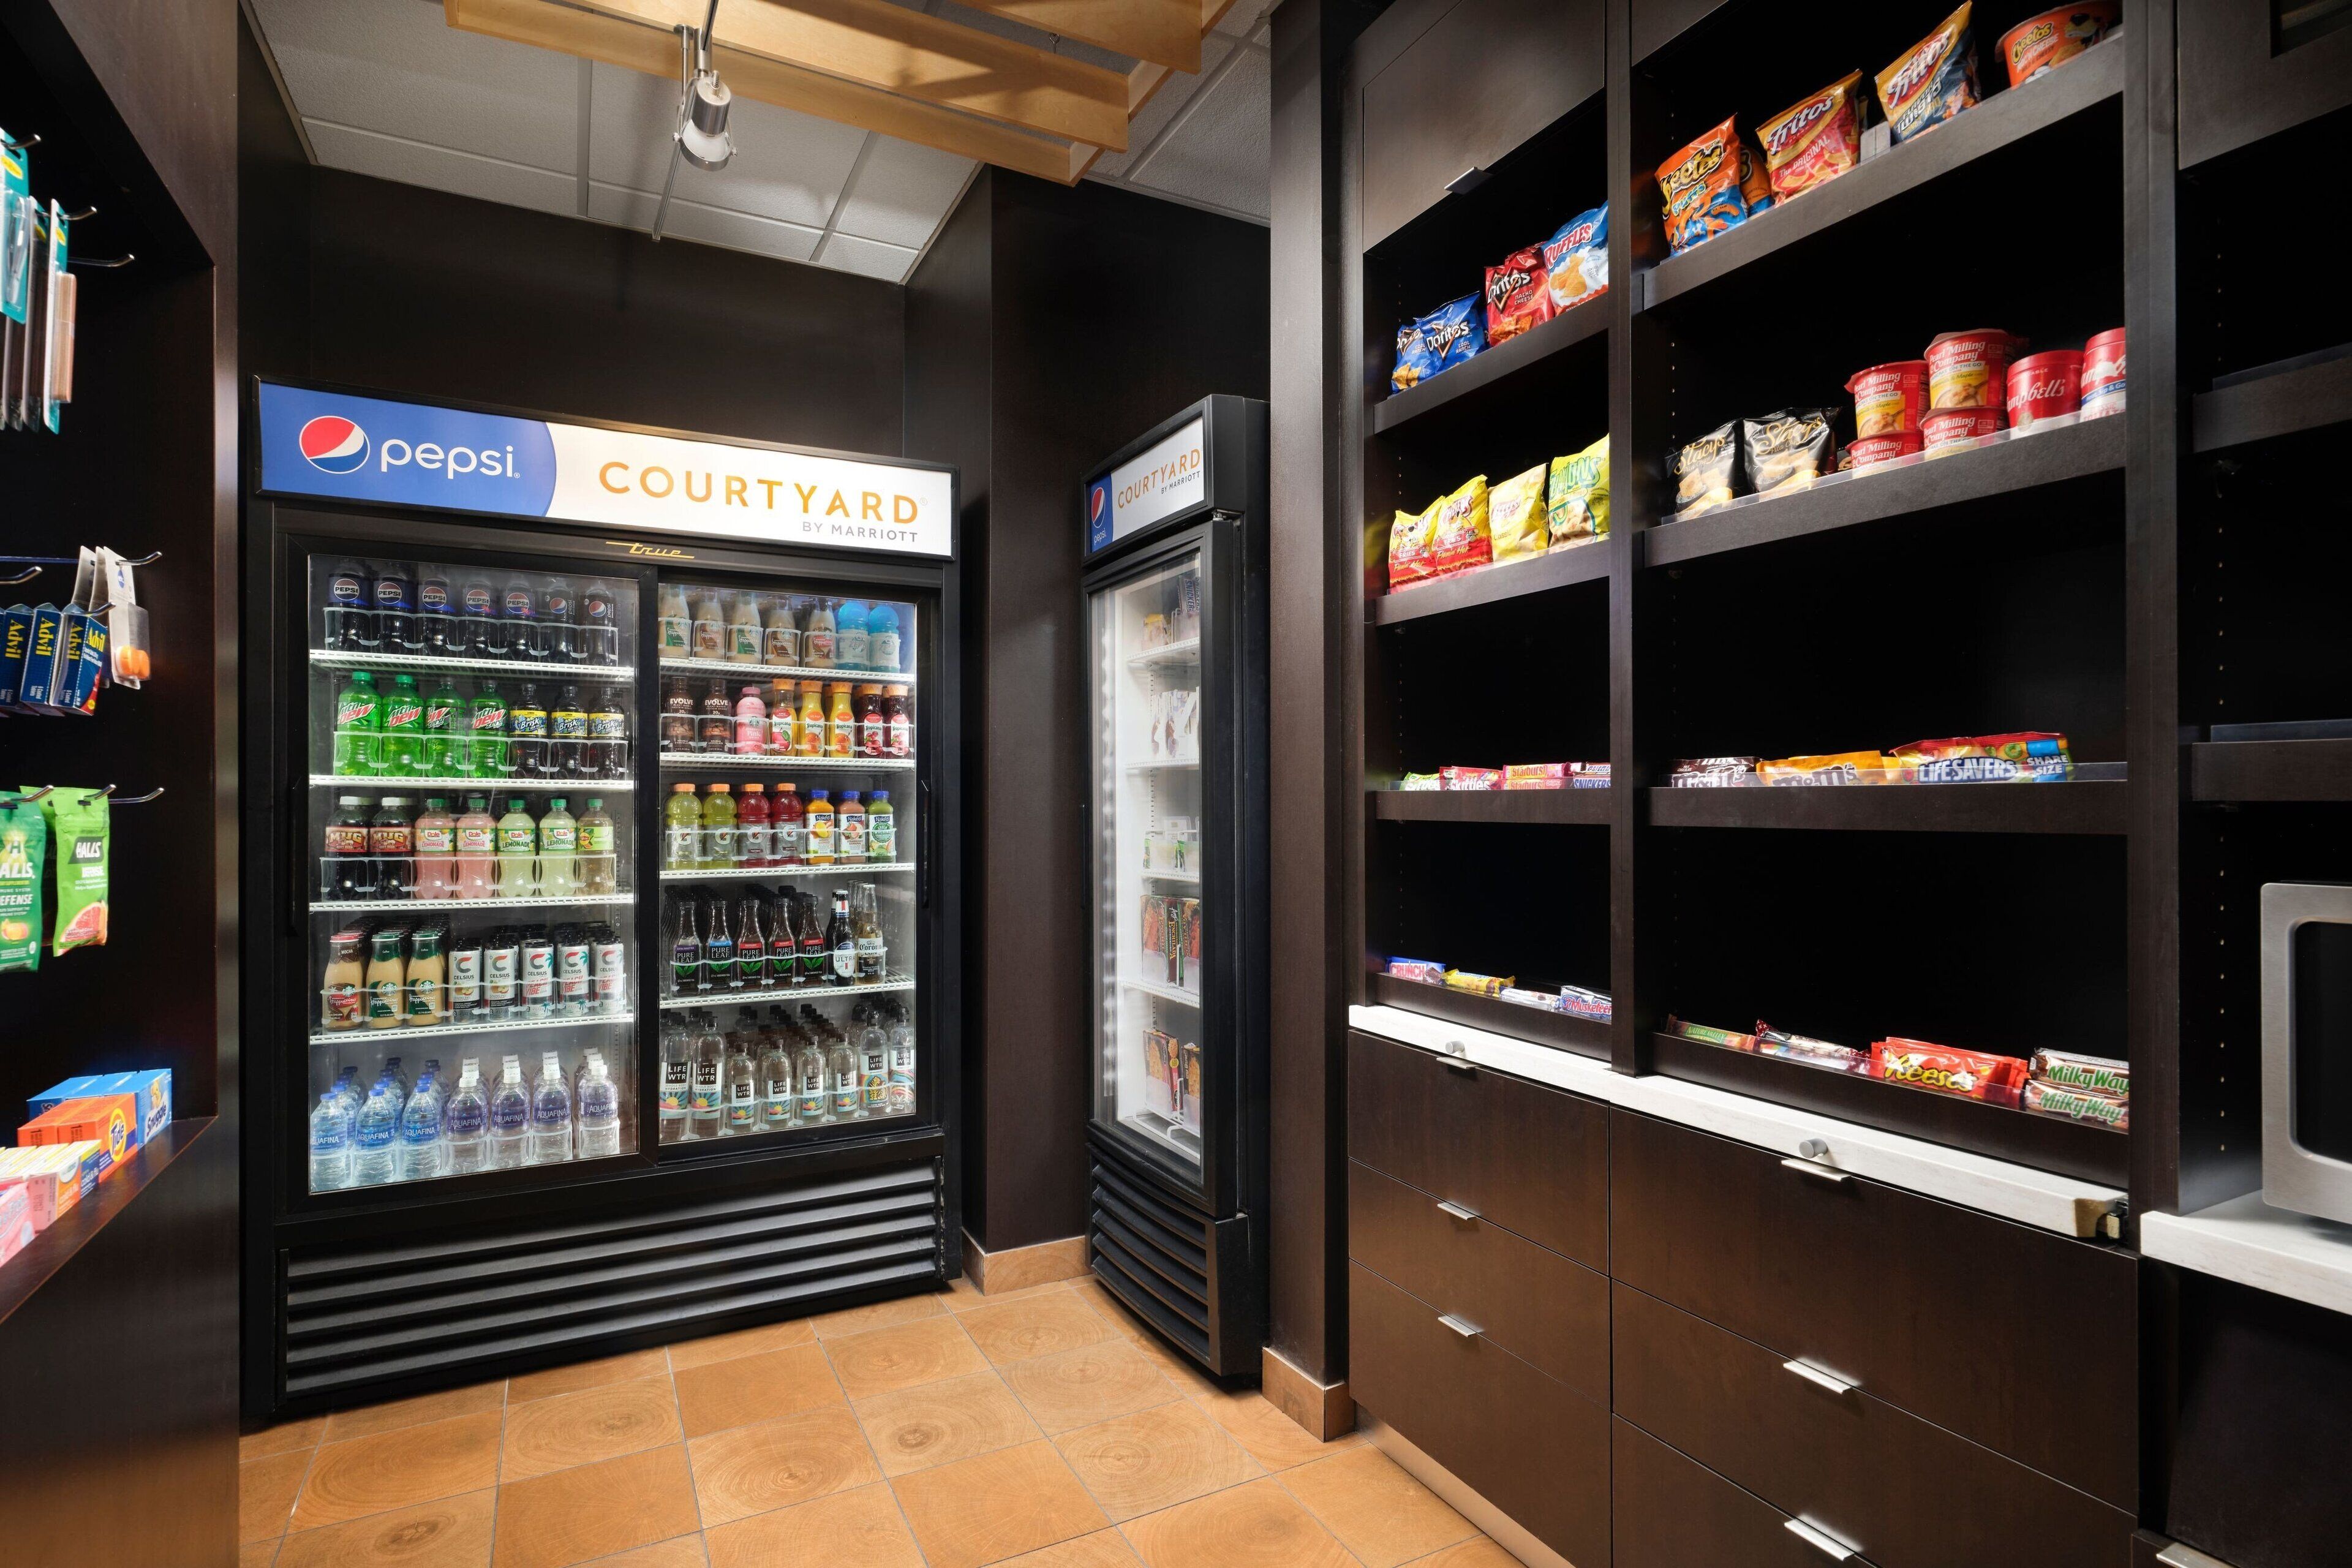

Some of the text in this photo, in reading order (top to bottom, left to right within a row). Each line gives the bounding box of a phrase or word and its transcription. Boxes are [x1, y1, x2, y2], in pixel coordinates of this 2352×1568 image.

[2011, 23, 2053, 64] Cheetos
[1767, 96, 1834, 156] Fritos
[1793, 135, 1830, 169] ORIGINAL
[1544, 223, 1593, 269] RUFFLES
[1487, 271, 1531, 304] Doritos
[1515, 290, 1533, 300] NACHO
[1514, 295, 1534, 305] CHEESE
[1427, 321, 1469, 352] Doritos
[1947, 341, 1986, 355] Milling
[1934, 352, 1979, 370] Company
[1868, 372, 1901, 385] Milling
[1858, 383, 1895, 400] Company
[1939, 417, 1976, 429] Milling
[1755, 417, 1822, 455] Stacy's
[1927, 426, 1968, 445] Company
[1673, 434, 1725, 476] Stacy's
[1868, 440, 1902, 454] Milling
[381, 439, 514, 479] pepsi
[1855, 450, 1896, 467] Company
[1118, 448, 1200, 509] COURTYARD
[1169, 471, 1200, 490] MARRIOTT
[599, 461, 918, 524] COURTYARD
[802, 521, 918, 543] BY MARRIOTT
[1094, 527, 1106, 546] pepsi
[606, 541, 695, 559] true
[1458, 546, 1471, 555] Hot
[5, 619, 25, 659] Advil
[36, 617, 56, 656] Advil
[67, 622, 84, 660] Advil
[86, 627, 106, 652] Advil
[2026, 755, 2068, 766] SHARE
[1512, 766, 1547, 778] Starburst
[2035, 765, 2063, 775] SIZE
[330, 832, 363, 844] MUG
[373, 832, 404, 843] MUG
[0, 894, 34, 906] EFENSE
[1391, 962, 1425, 979] CRUNCH
[1687, 1026, 1726, 1040] NATURE VALLEY
[146, 1103, 167, 1135] Snuggle
[450, 1117, 481, 1128] AQUAFINA
[494, 1114, 524, 1123] AQUAFINA
[537, 1108, 567, 1119] AQUAFINA
[109, 1117, 124, 1156] Tide
[357, 1131, 389, 1142] AQUAFINA
[405, 1127, 435, 1137] AQUAFINA
